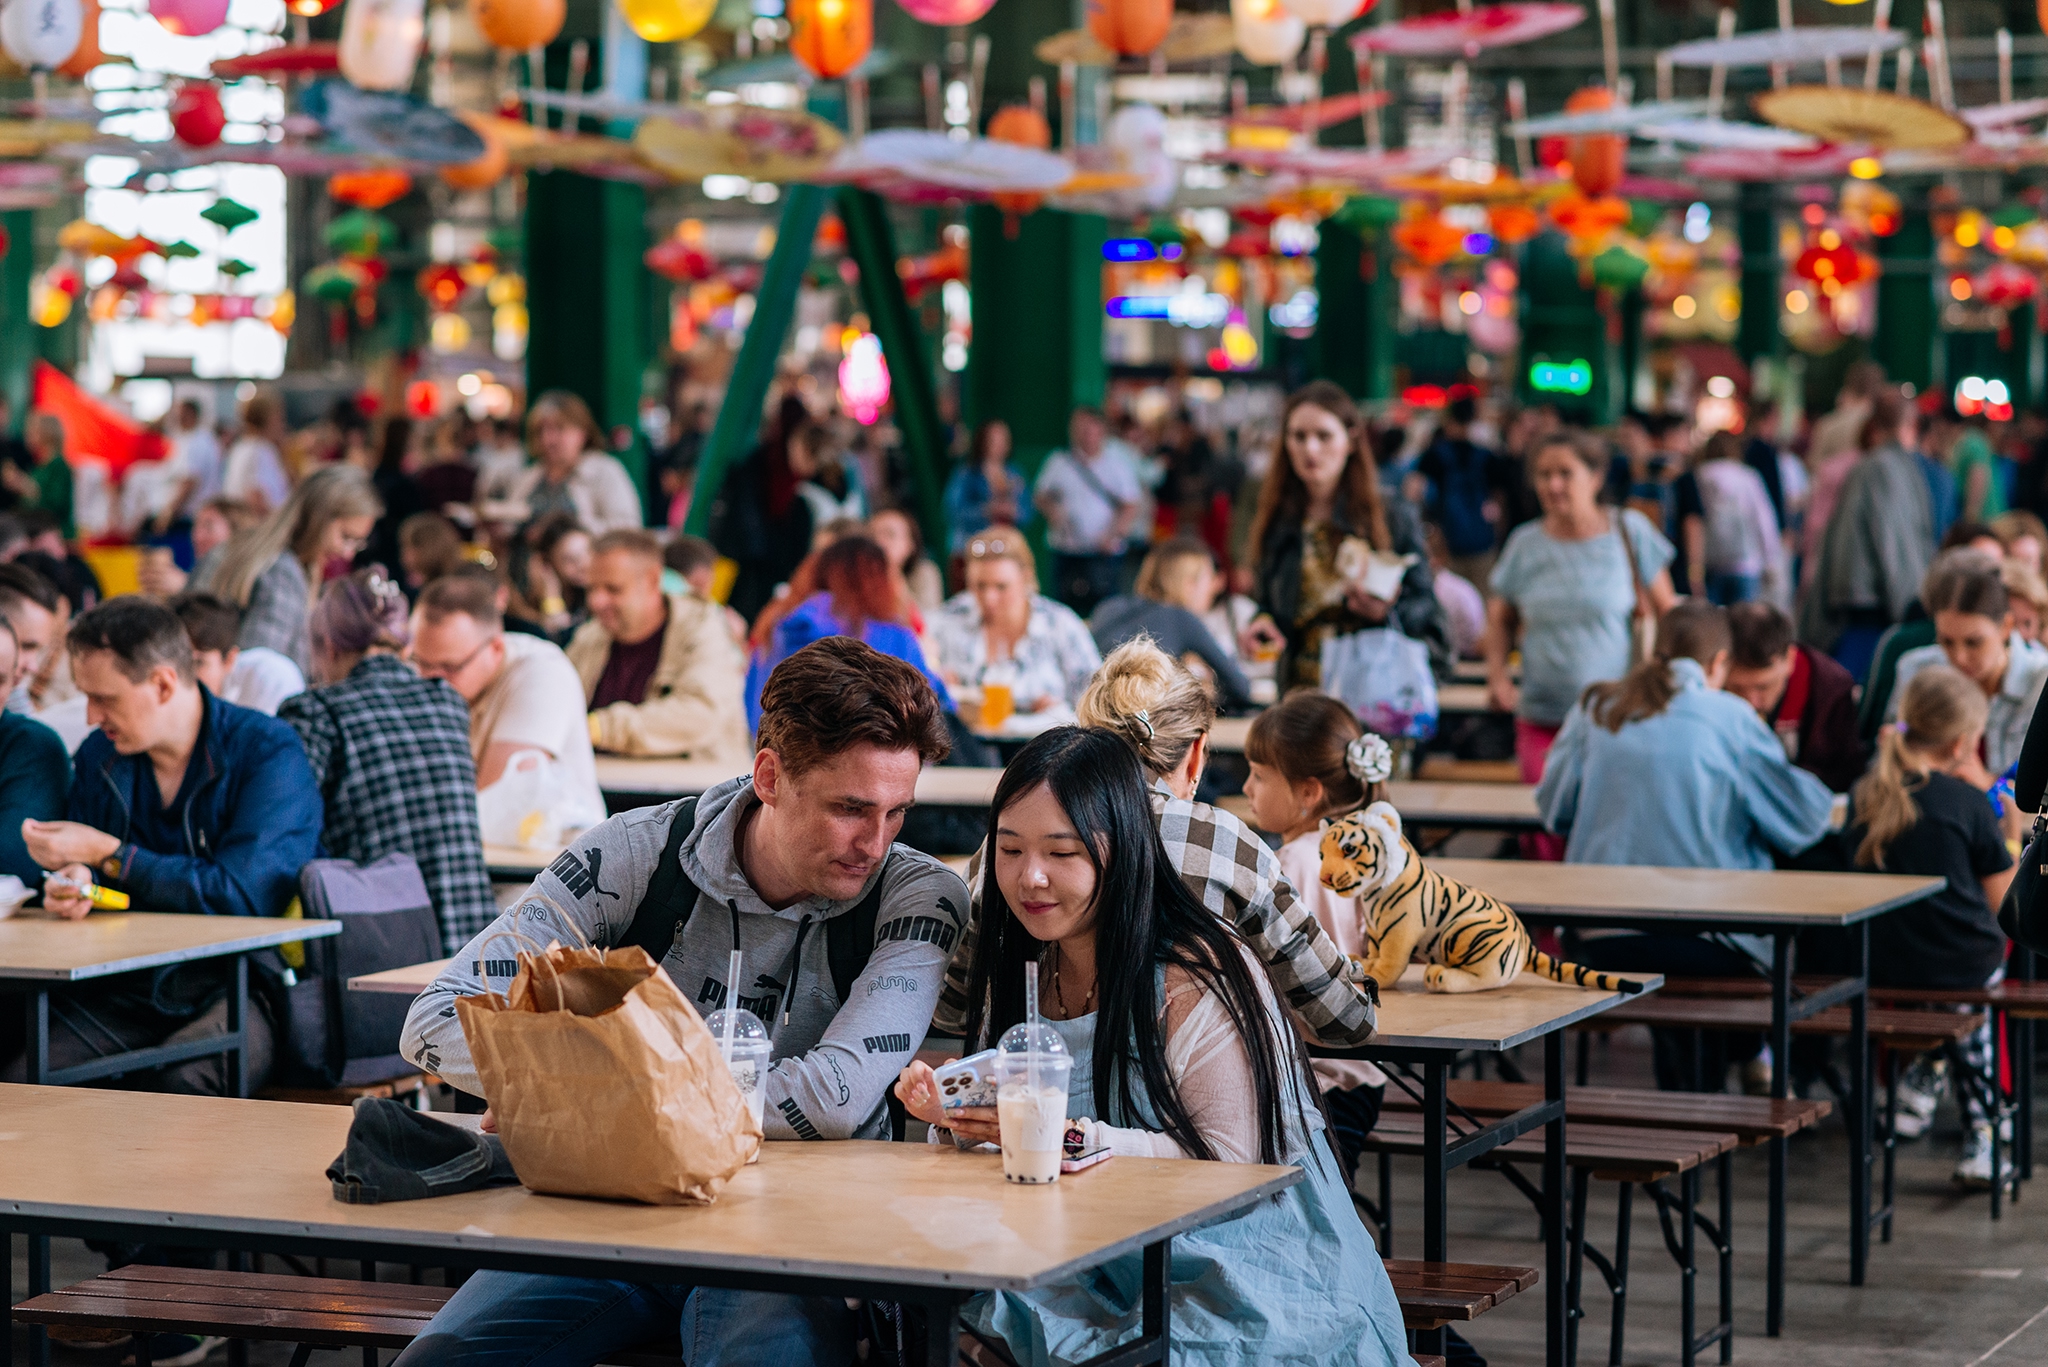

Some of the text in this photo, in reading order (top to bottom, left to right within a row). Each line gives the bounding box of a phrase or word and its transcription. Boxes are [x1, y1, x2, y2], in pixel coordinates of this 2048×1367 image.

[873, 915, 957, 954] PUMA
[472, 959, 519, 977] PUM
[867, 975, 918, 996] puma
[863, 1033, 910, 1054] PUMA
